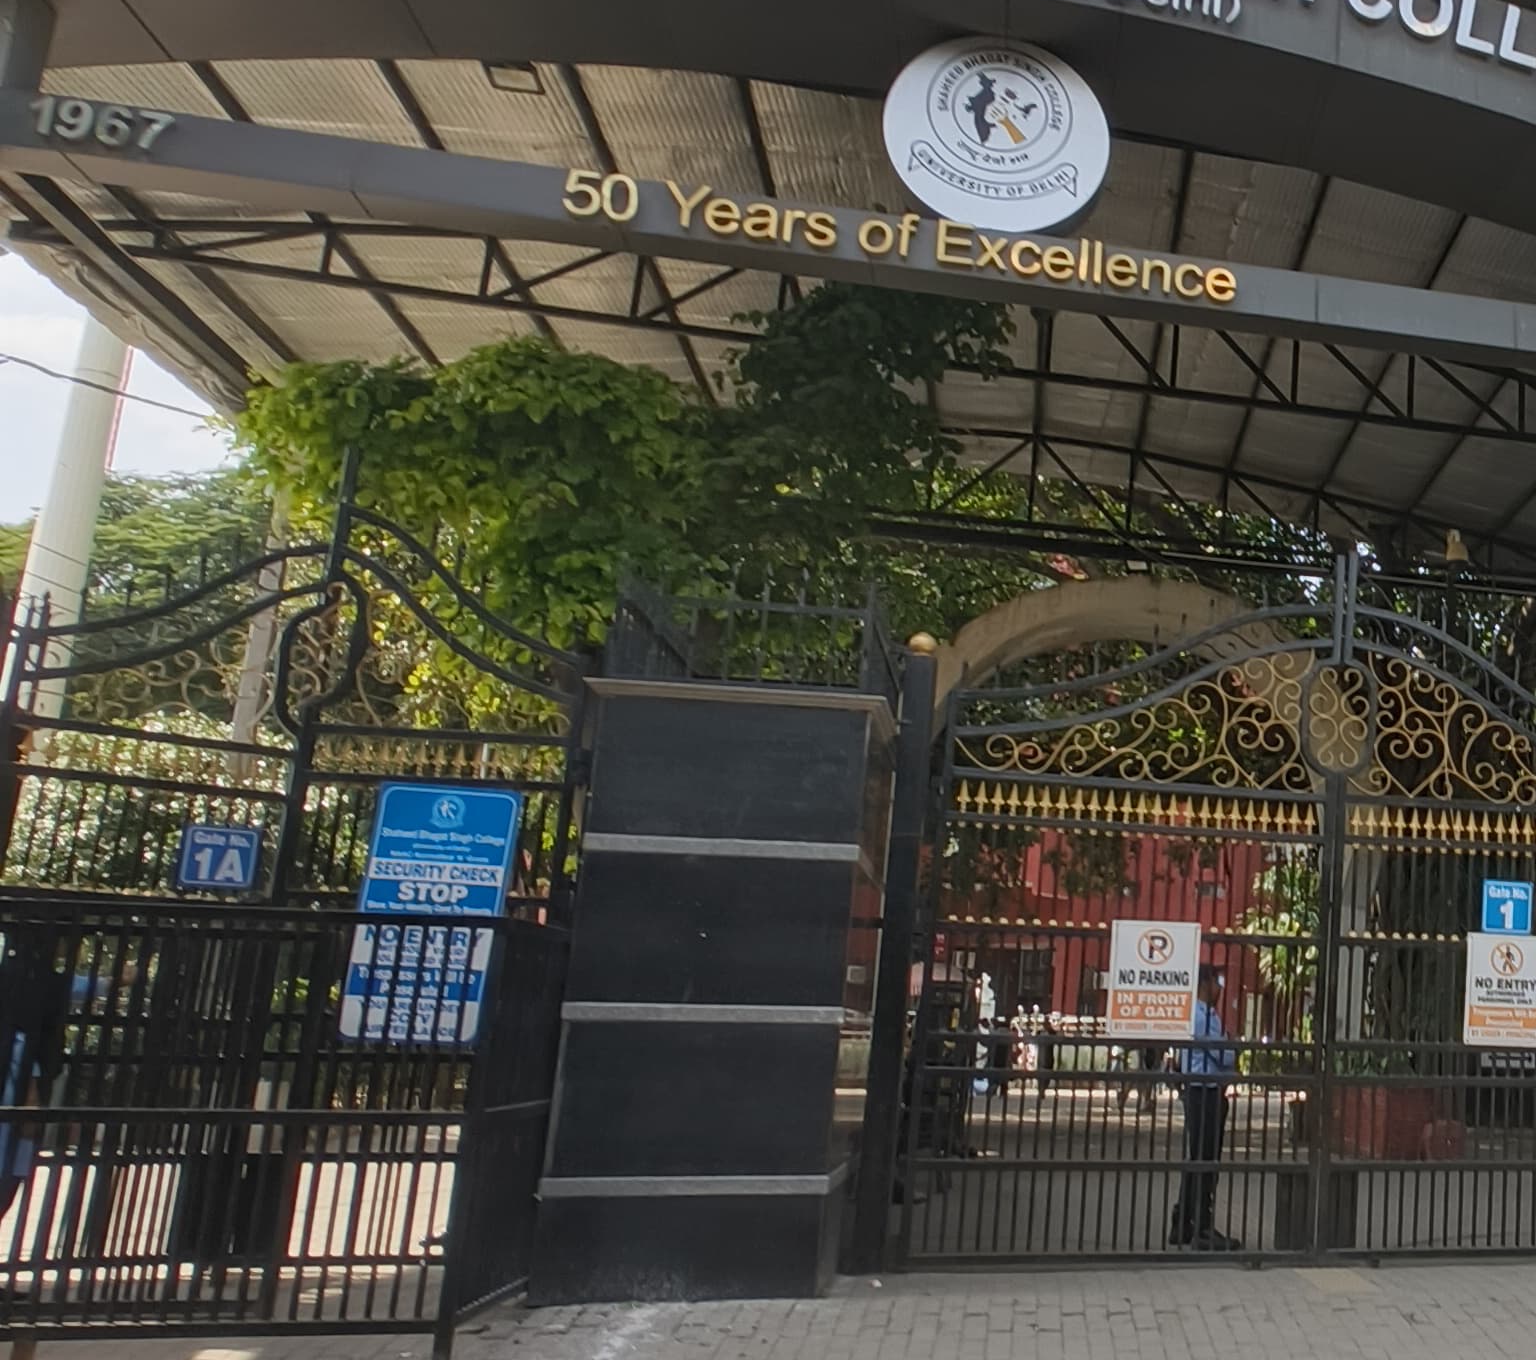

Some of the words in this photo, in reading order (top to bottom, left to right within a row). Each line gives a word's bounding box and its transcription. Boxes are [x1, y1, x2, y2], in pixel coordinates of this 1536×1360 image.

[29, 95, 177, 150] 1967
[917, 148, 1001, 197] UNIVERSITY
[1006, 185, 1025, 197] OF
[1031, 170, 1071, 195] DELHI
[562, 167, 640, 223] 50
[664, 179, 838, 248] Years
[857, 212, 921, 258] of
[935, 217, 1238, 304] Excellence
[194, 847, 244, 883] 1A
[373, 861, 446, 880] SECURITY
[450, 866, 498, 883] CHECK
[397, 881, 469, 904] STOP
[1500, 900, 1514, 930] 1
[1118, 968, 1136, 985] NO
[1139, 970, 1189, 987] PARKING
[1475, 977, 1493, 989] NO
[1497, 978, 1536, 991] ENTRY
[1117, 992, 1133, 1004] IN
[1138, 992, 1187, 1006] FRONT
[1120, 1005, 1140, 1017] OF
[1145, 1006, 1183, 1018] GATE
